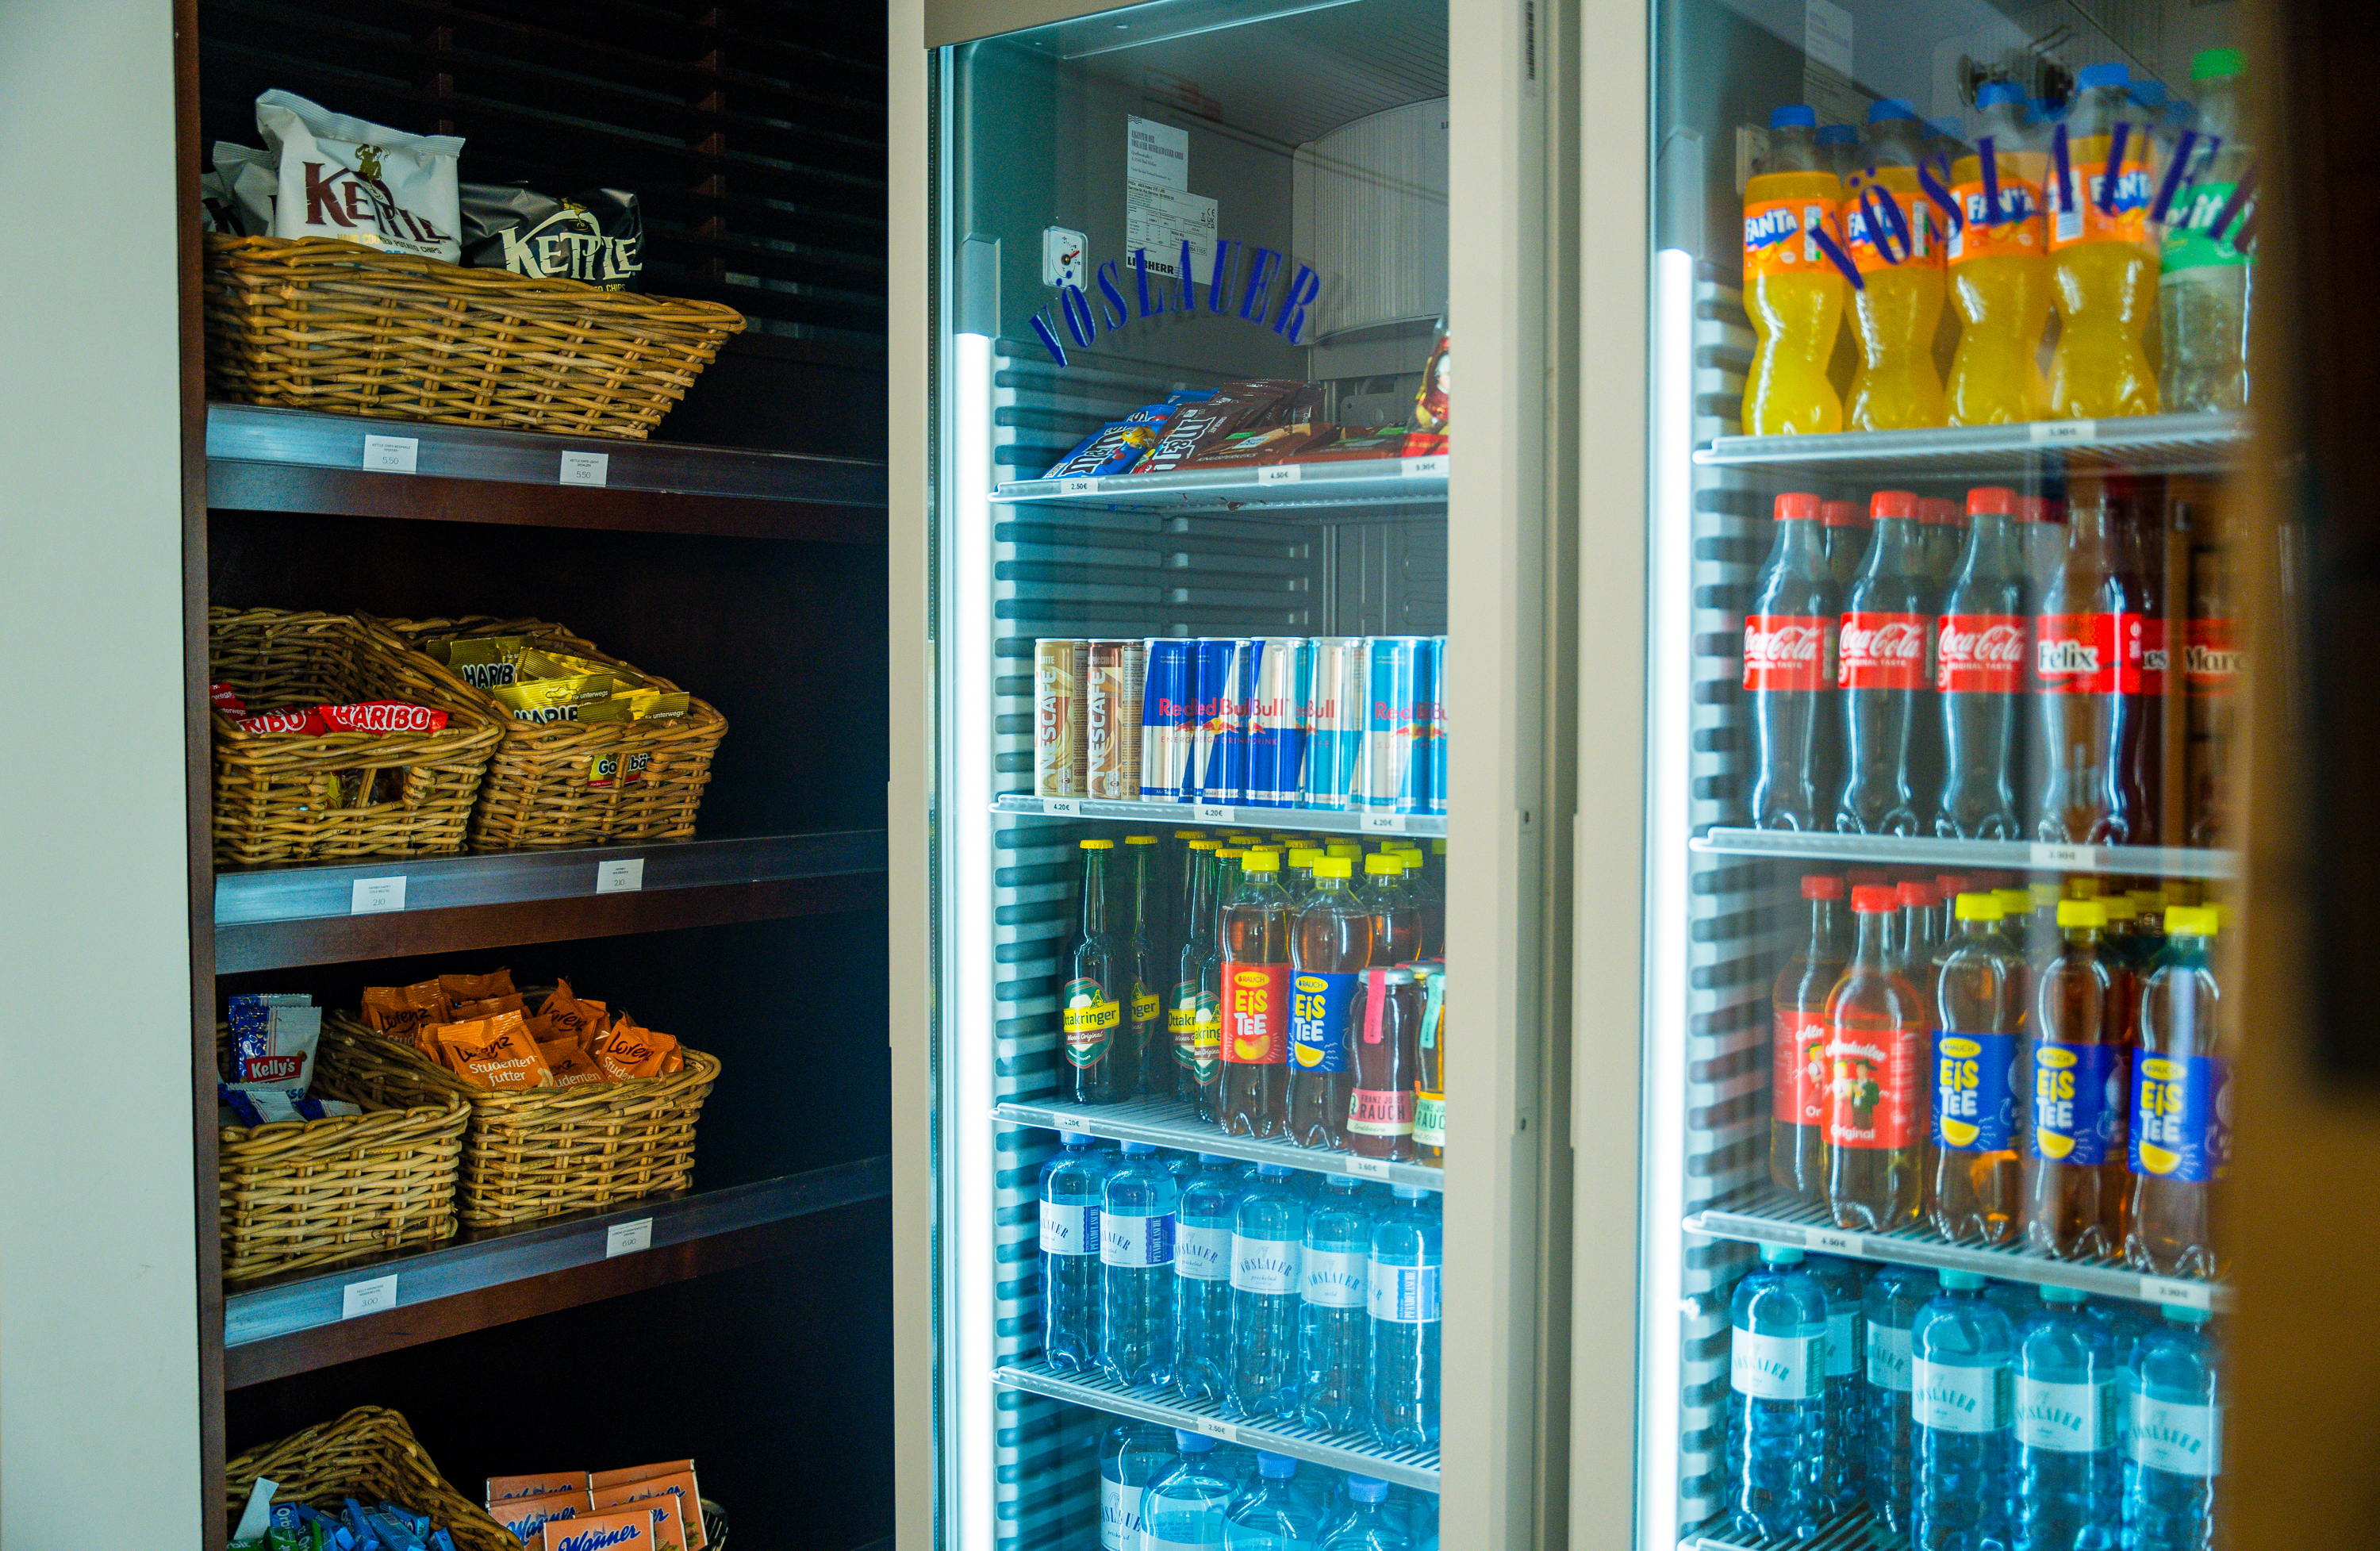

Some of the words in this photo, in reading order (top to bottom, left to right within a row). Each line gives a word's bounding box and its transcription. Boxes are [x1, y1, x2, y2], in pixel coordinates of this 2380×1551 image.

[1745, 207, 1798, 244] FANTA
[393, 240, 419, 252] POTATO
[420, 246, 443, 255] CHIPS
[498, 209, 643, 281] KETTLE
[1028, 240, 1320, 368] VÖSLAUER
[382, 456, 399, 465] 5.50
[576, 470, 591, 479] 5.50
[2039, 642, 2096, 670] Felix
[462, 663, 516, 689] HARIB
[580, 689, 608, 700] unterwegs
[333, 704, 431, 731] HARIBO
[1375, 701, 1414, 720] Red
[239, 708, 306, 735] RIBO
[1081, 1030, 1104, 1043] Original
[607, 1031, 654, 1062] Lorenz
[1825, 1038, 1887, 1062] Almdudler
[251, 1058, 295, 1079] Kelly's
[488, 1071, 526, 1087] futter
[1359, 1104, 1406, 1120] RAUCH
[1416, 1111, 1445, 1130] RAUC
[1830, 1123, 1875, 1140] Original
[1240, 1257, 1292, 1277] VÖSLAUER
[362, 1297, 378, 1307] 3.00
[1207, 1424, 1226, 1434] 2.50€
[558, 1523, 643, 1551] Manner
